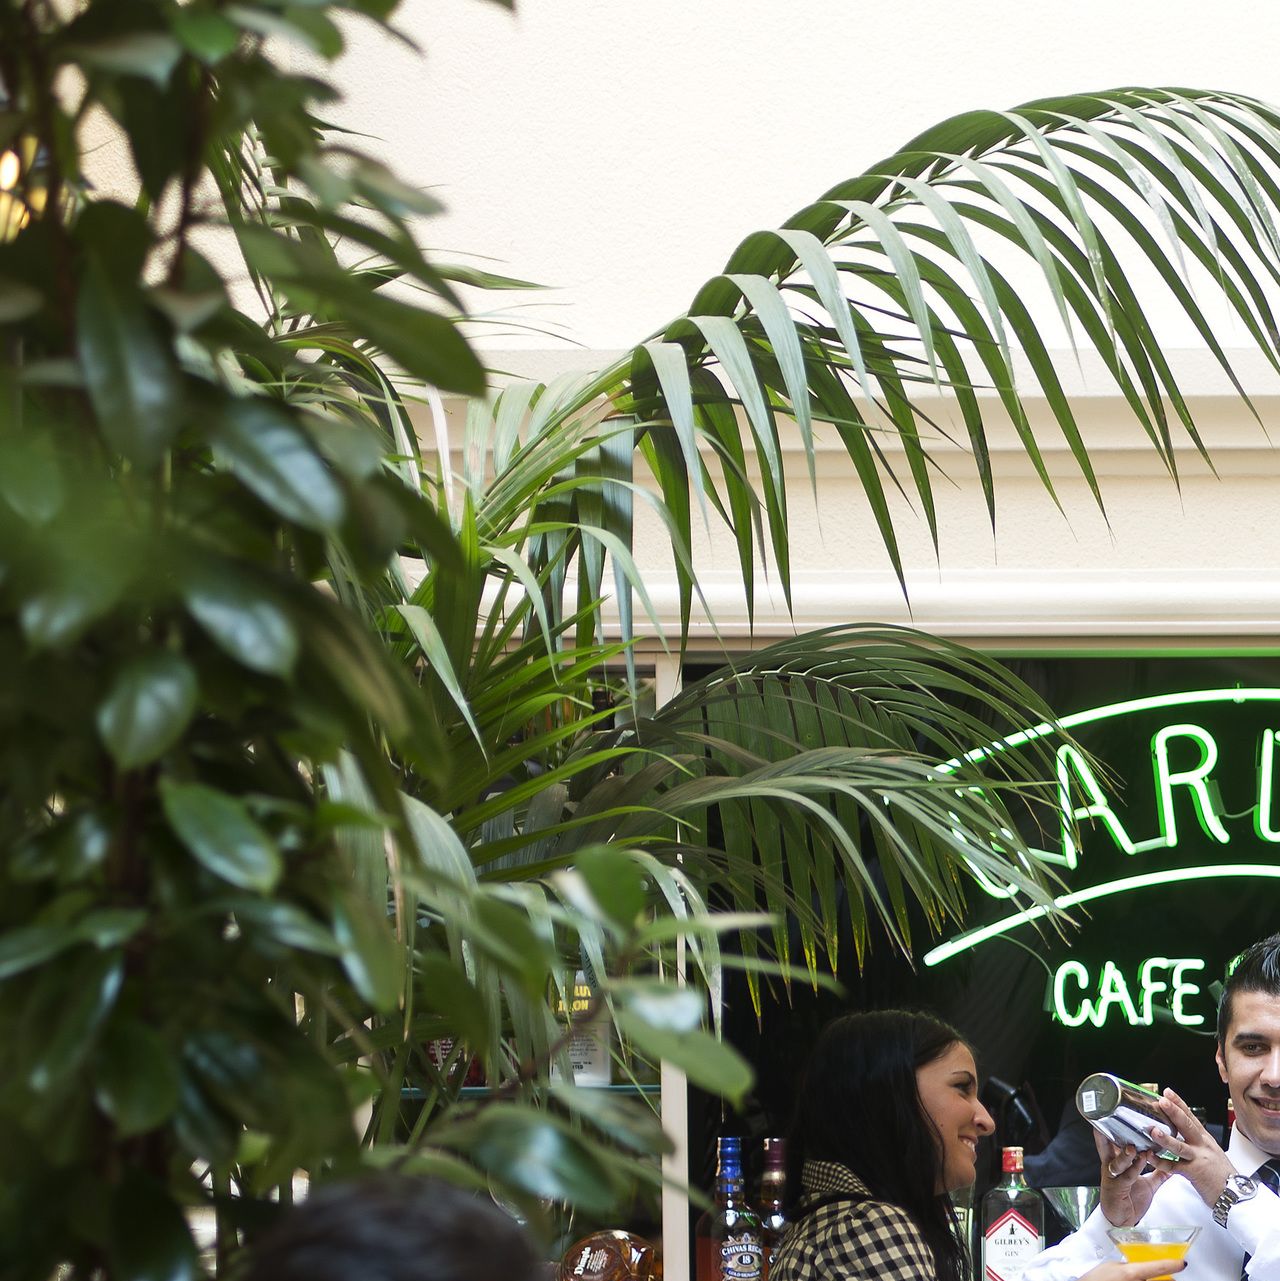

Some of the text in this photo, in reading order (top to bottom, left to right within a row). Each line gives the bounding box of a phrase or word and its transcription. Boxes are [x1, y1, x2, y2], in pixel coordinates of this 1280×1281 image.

[1054, 958, 1206, 1028] CAFE
[721, 1245, 747, 1256] CHIVAS
[742, 1255, 751, 1264] 18
